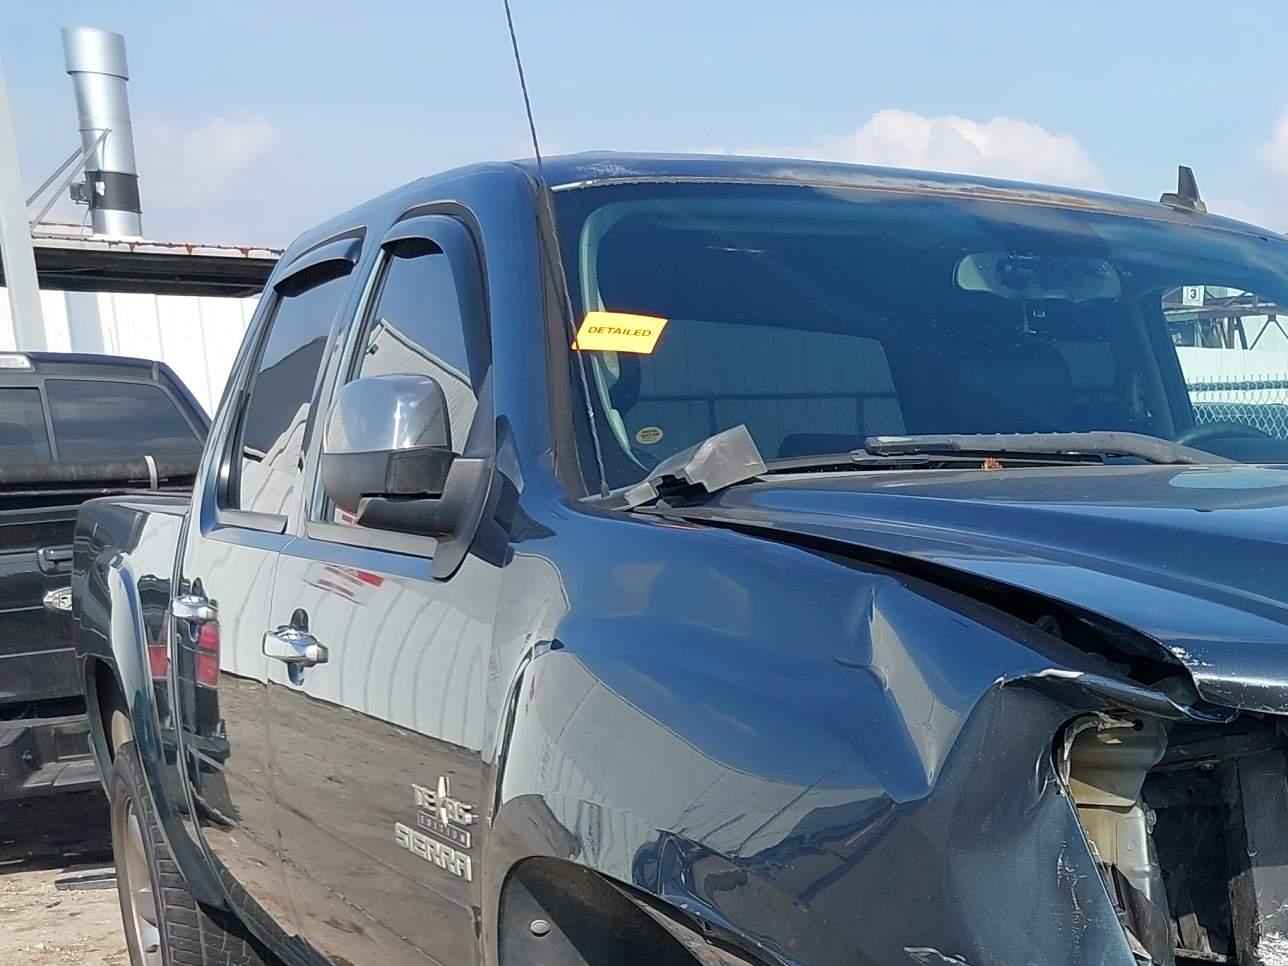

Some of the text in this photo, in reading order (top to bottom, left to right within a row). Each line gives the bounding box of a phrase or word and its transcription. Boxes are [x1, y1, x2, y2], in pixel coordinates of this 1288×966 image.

[1190, 289, 1197, 299] 3
[588, 326, 652, 337] DETAILED
[395, 822, 472, 881] SIERRA
